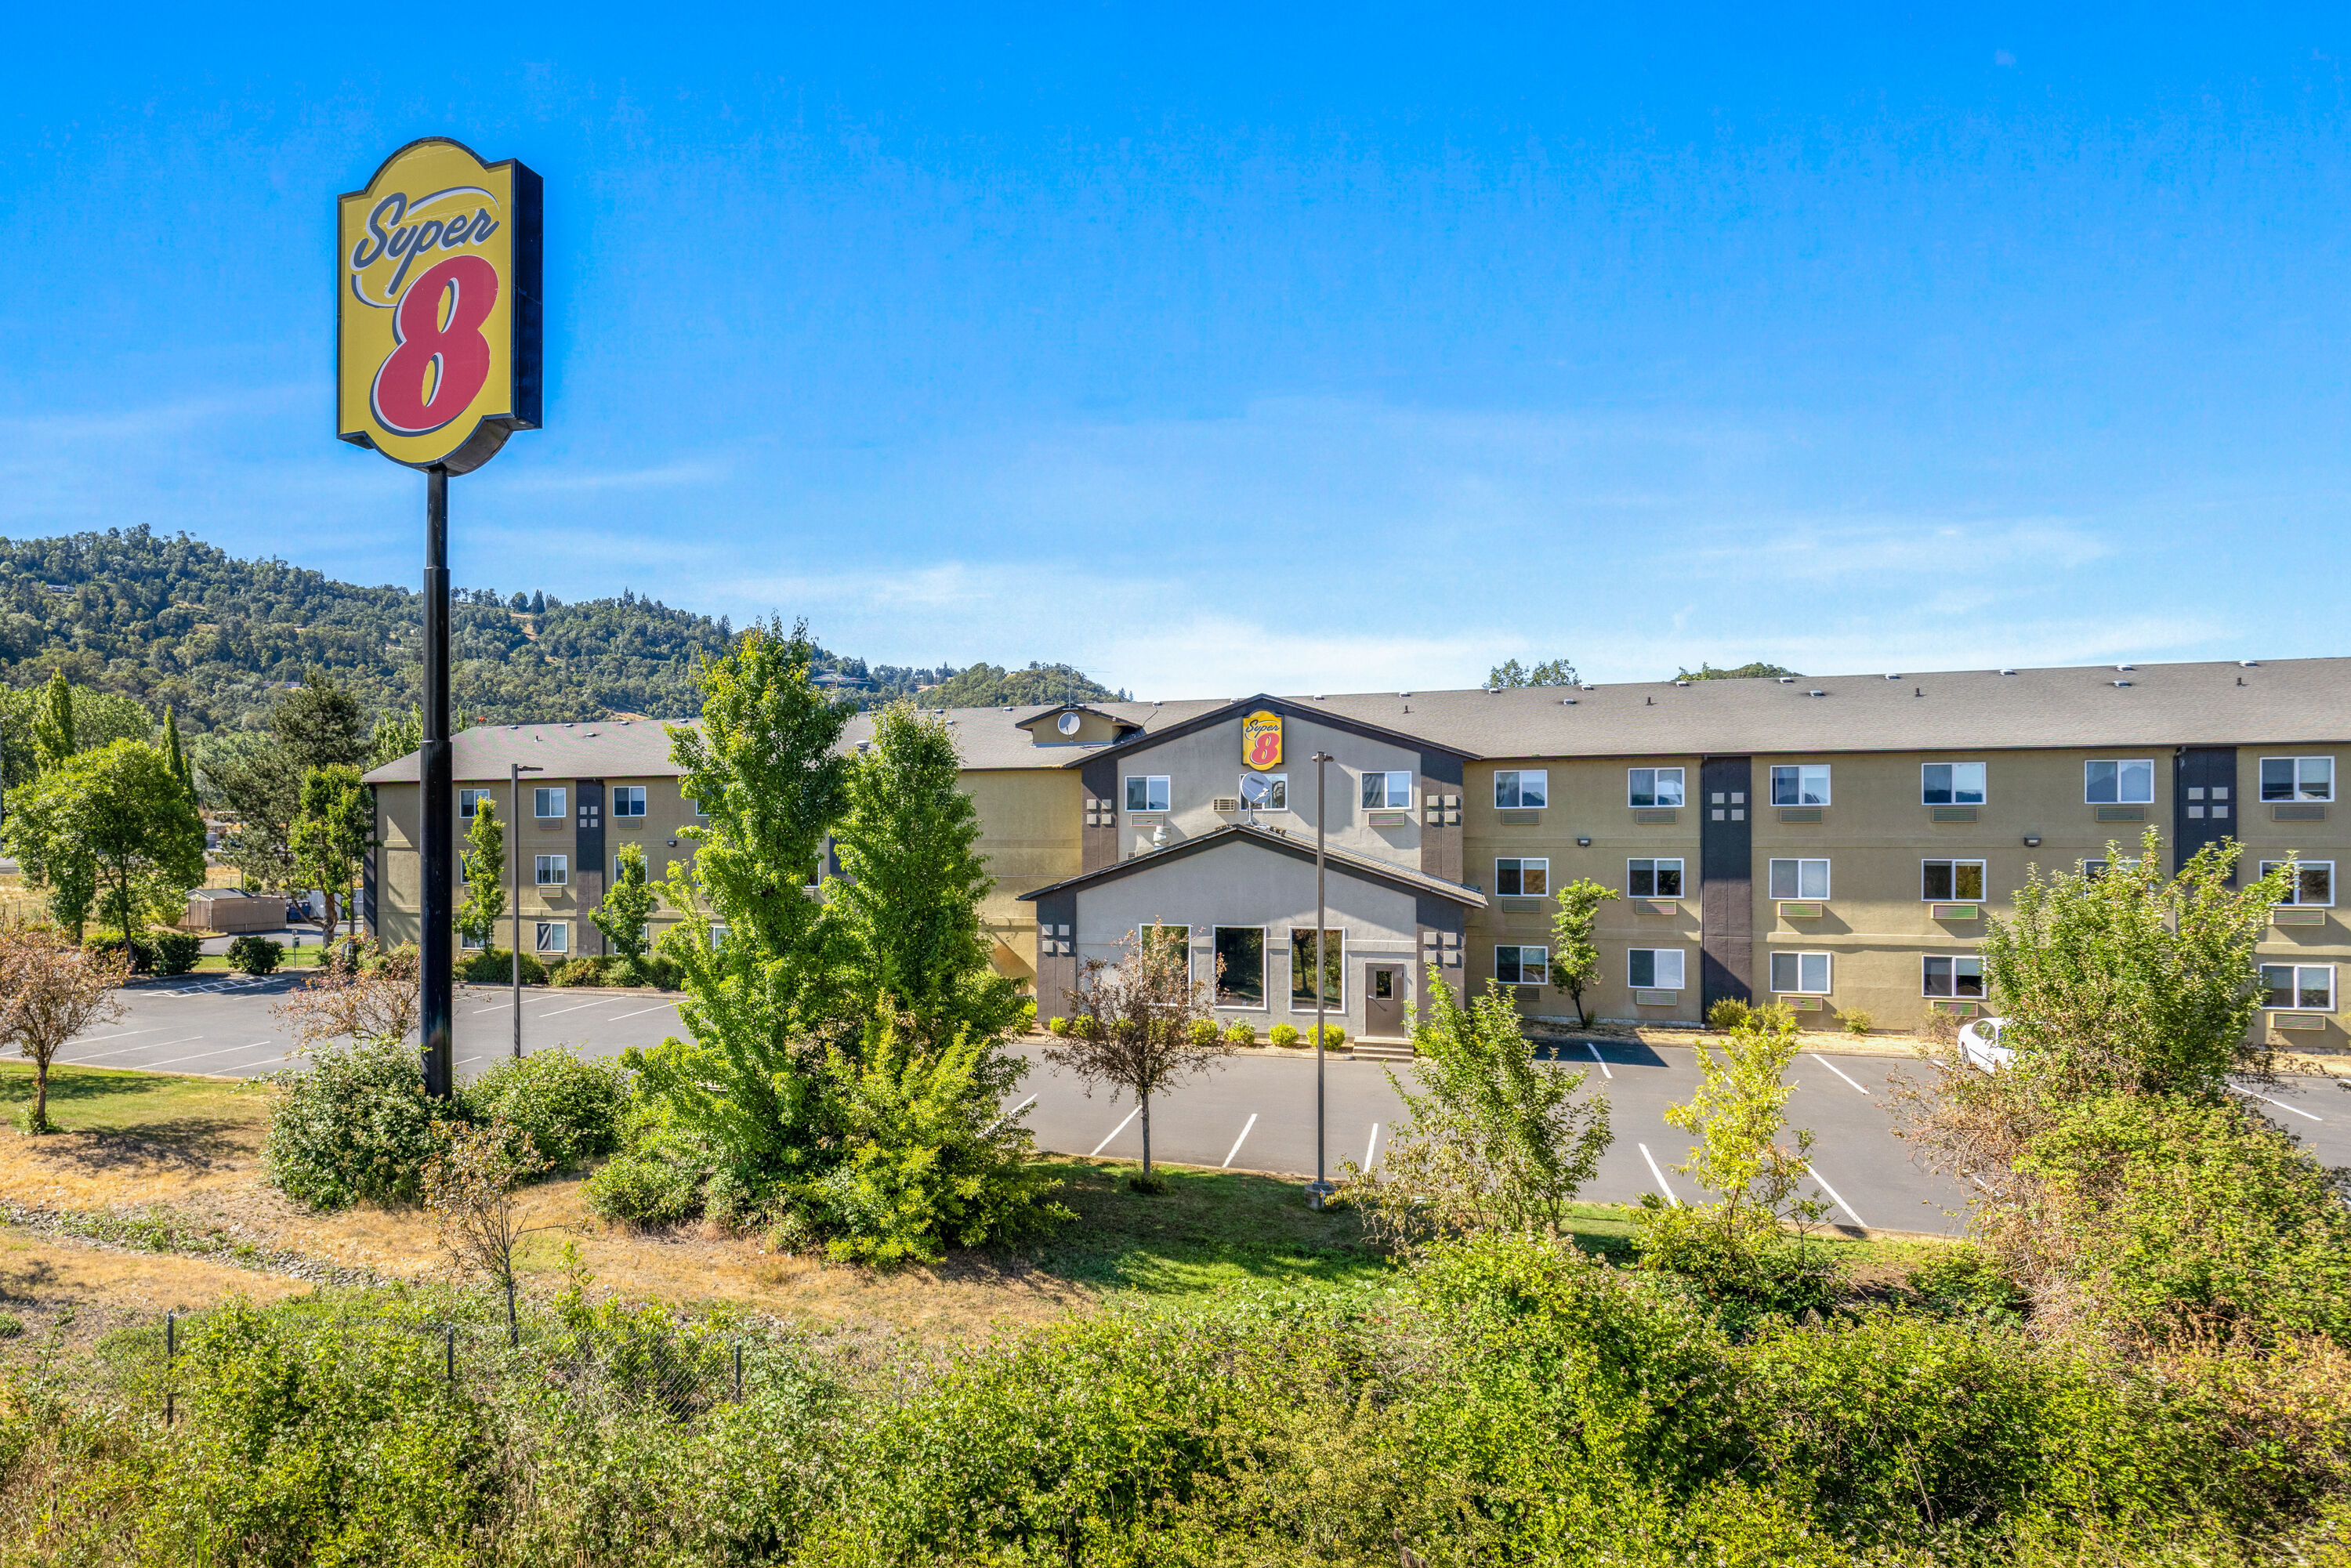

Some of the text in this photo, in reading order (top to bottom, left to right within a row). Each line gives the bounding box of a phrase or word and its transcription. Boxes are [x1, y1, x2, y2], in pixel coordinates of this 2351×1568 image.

[350, 192, 500, 298] Super
[369, 255, 499, 437] 8
[1244, 719, 1280, 738] Super
[1249, 733, 1280, 765] 8
